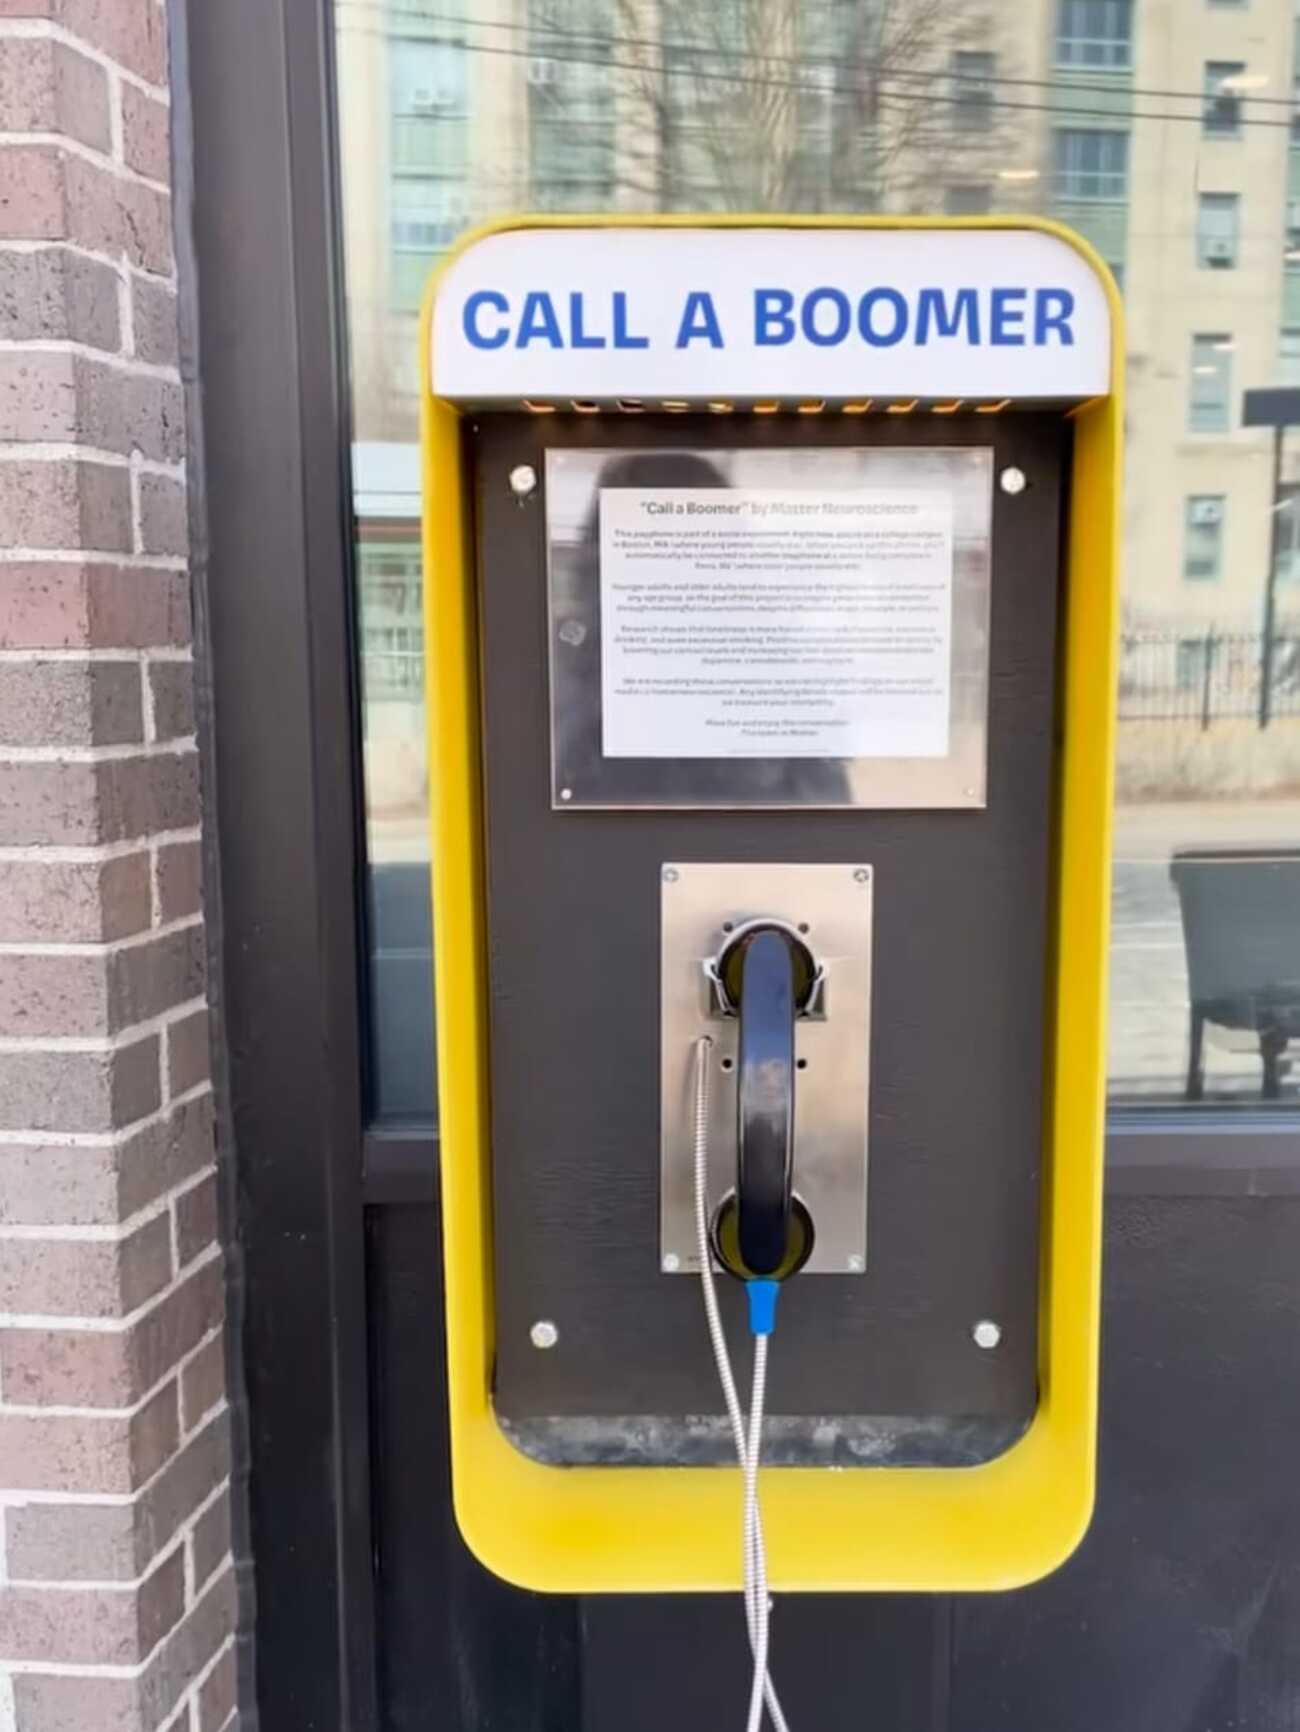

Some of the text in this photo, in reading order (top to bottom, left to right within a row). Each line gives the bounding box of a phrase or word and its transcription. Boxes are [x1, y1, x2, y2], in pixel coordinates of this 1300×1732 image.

[462, 286, 1076, 350] CALL A BOOMER
[641, 501, 674, 515] "Call
[676, 504, 685, 515] a
[751, 501, 768, 518] by
